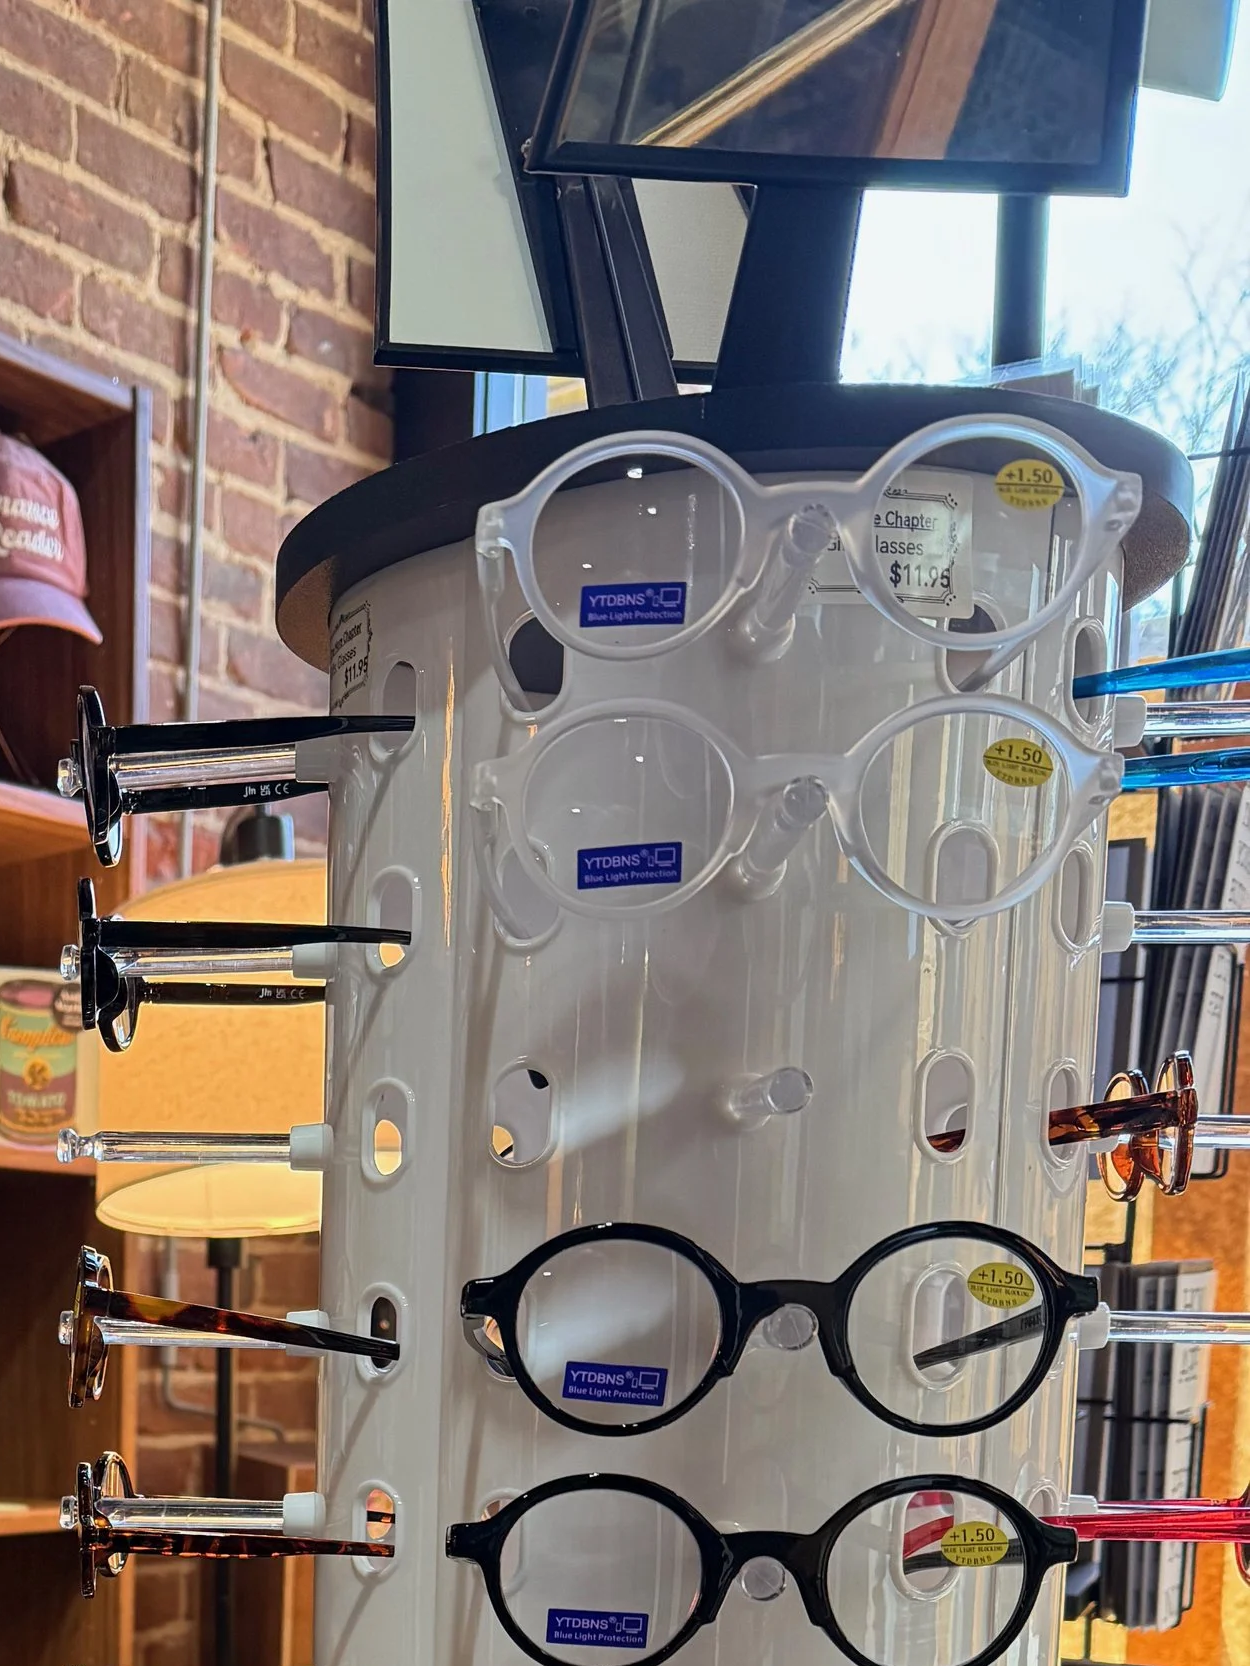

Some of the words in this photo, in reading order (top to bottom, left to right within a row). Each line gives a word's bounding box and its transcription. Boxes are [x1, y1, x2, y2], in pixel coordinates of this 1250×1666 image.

[1005, 467, 1053, 484] +1.50
[885, 510, 939, 532] Chapter
[889, 560, 951, 588] $11.95
[587, 611, 609, 621] Blue
[609, 610, 634, 622] Light
[634, 609, 682, 620] Protection
[994, 744, 1043, 764] +1.50
[584, 874, 604, 884] Blue
[605, 871, 630, 883] Light
[630, 869, 678, 880] Protection
[977, 1269, 1024, 1286] +1.50
[568, 1385, 587, 1395] Blue
[588, 1386, 612, 1398] Light
[613, 1390, 659, 1401] Protection
[949, 1527, 995, 1543] +1.50
[554, 1630, 573, 1640] Blue
[574, 1631, 597, 1642] Light
[598, 1633, 643, 1643] Protection
